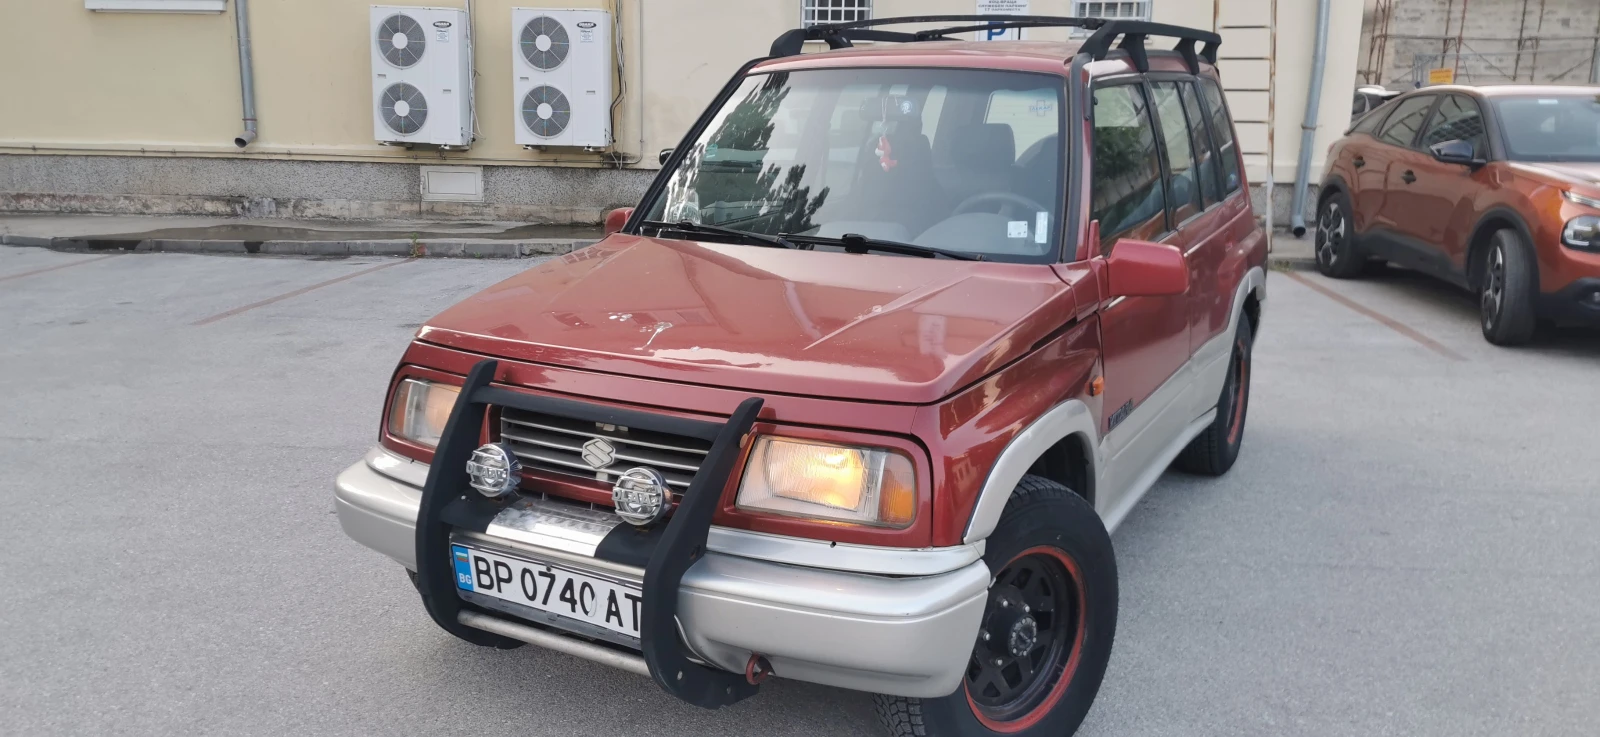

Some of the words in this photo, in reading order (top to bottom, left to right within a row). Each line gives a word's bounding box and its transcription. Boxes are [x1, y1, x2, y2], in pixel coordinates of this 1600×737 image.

[987, 20, 1006, 40] P
[459, 573, 472, 585] BG
[473, 555, 513, 593] BP
[520, 568, 597, 617] 0740
[605, 589, 642, 632] AT
